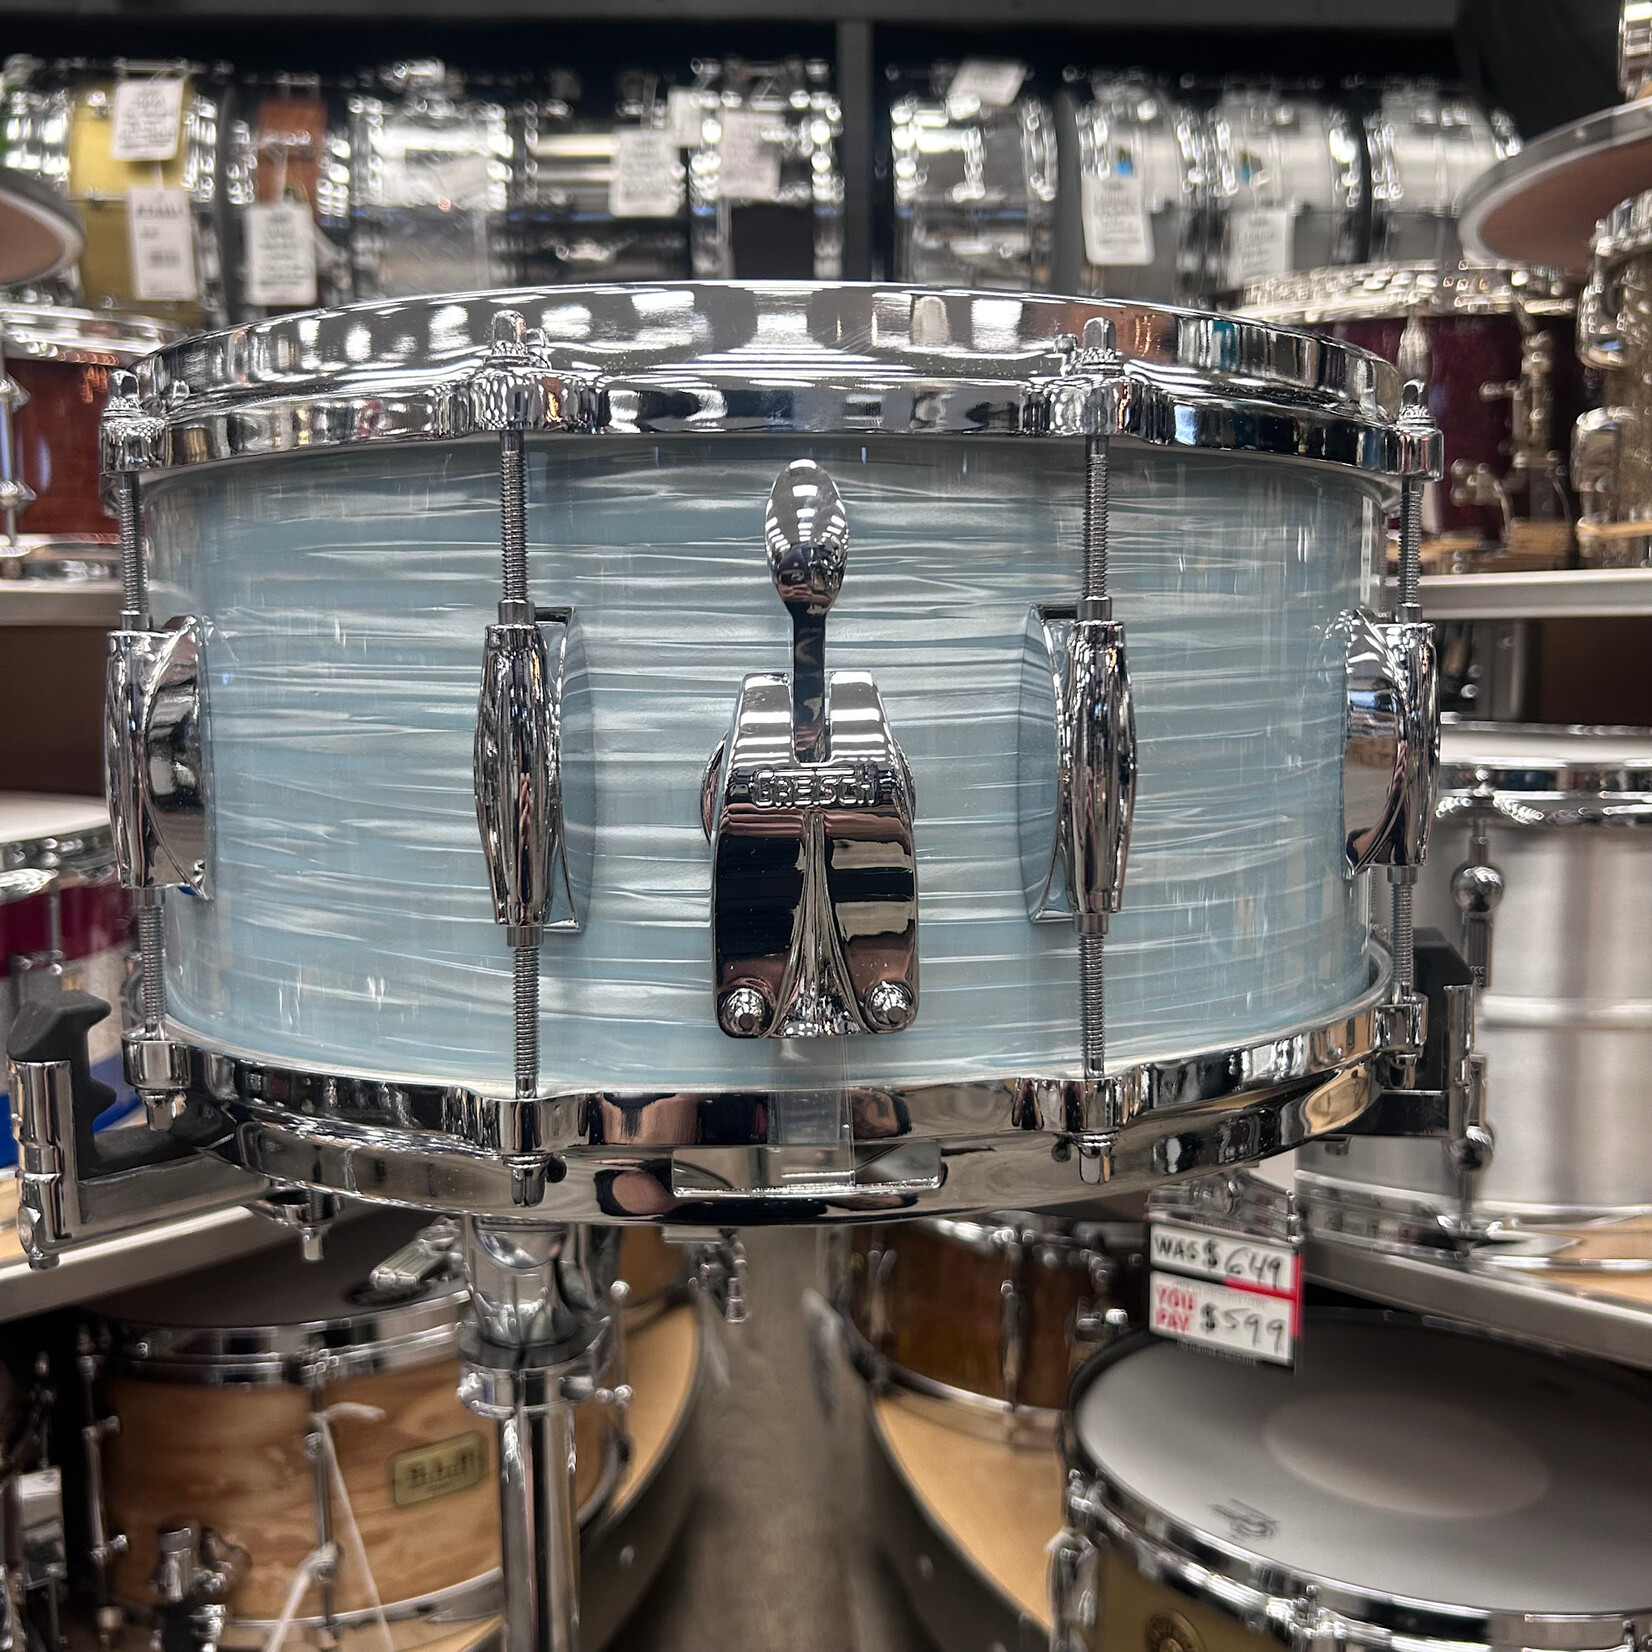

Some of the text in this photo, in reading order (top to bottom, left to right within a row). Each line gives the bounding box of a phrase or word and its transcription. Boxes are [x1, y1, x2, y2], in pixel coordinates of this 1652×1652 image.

[754, 766, 878, 808] GRETSCH
[1154, 1236, 1283, 1290] WAS $649
[1155, 1286, 1196, 1311] YOU
[1154, 1307, 1191, 1333] PAY
[1200, 1302, 1287, 1353] $599
